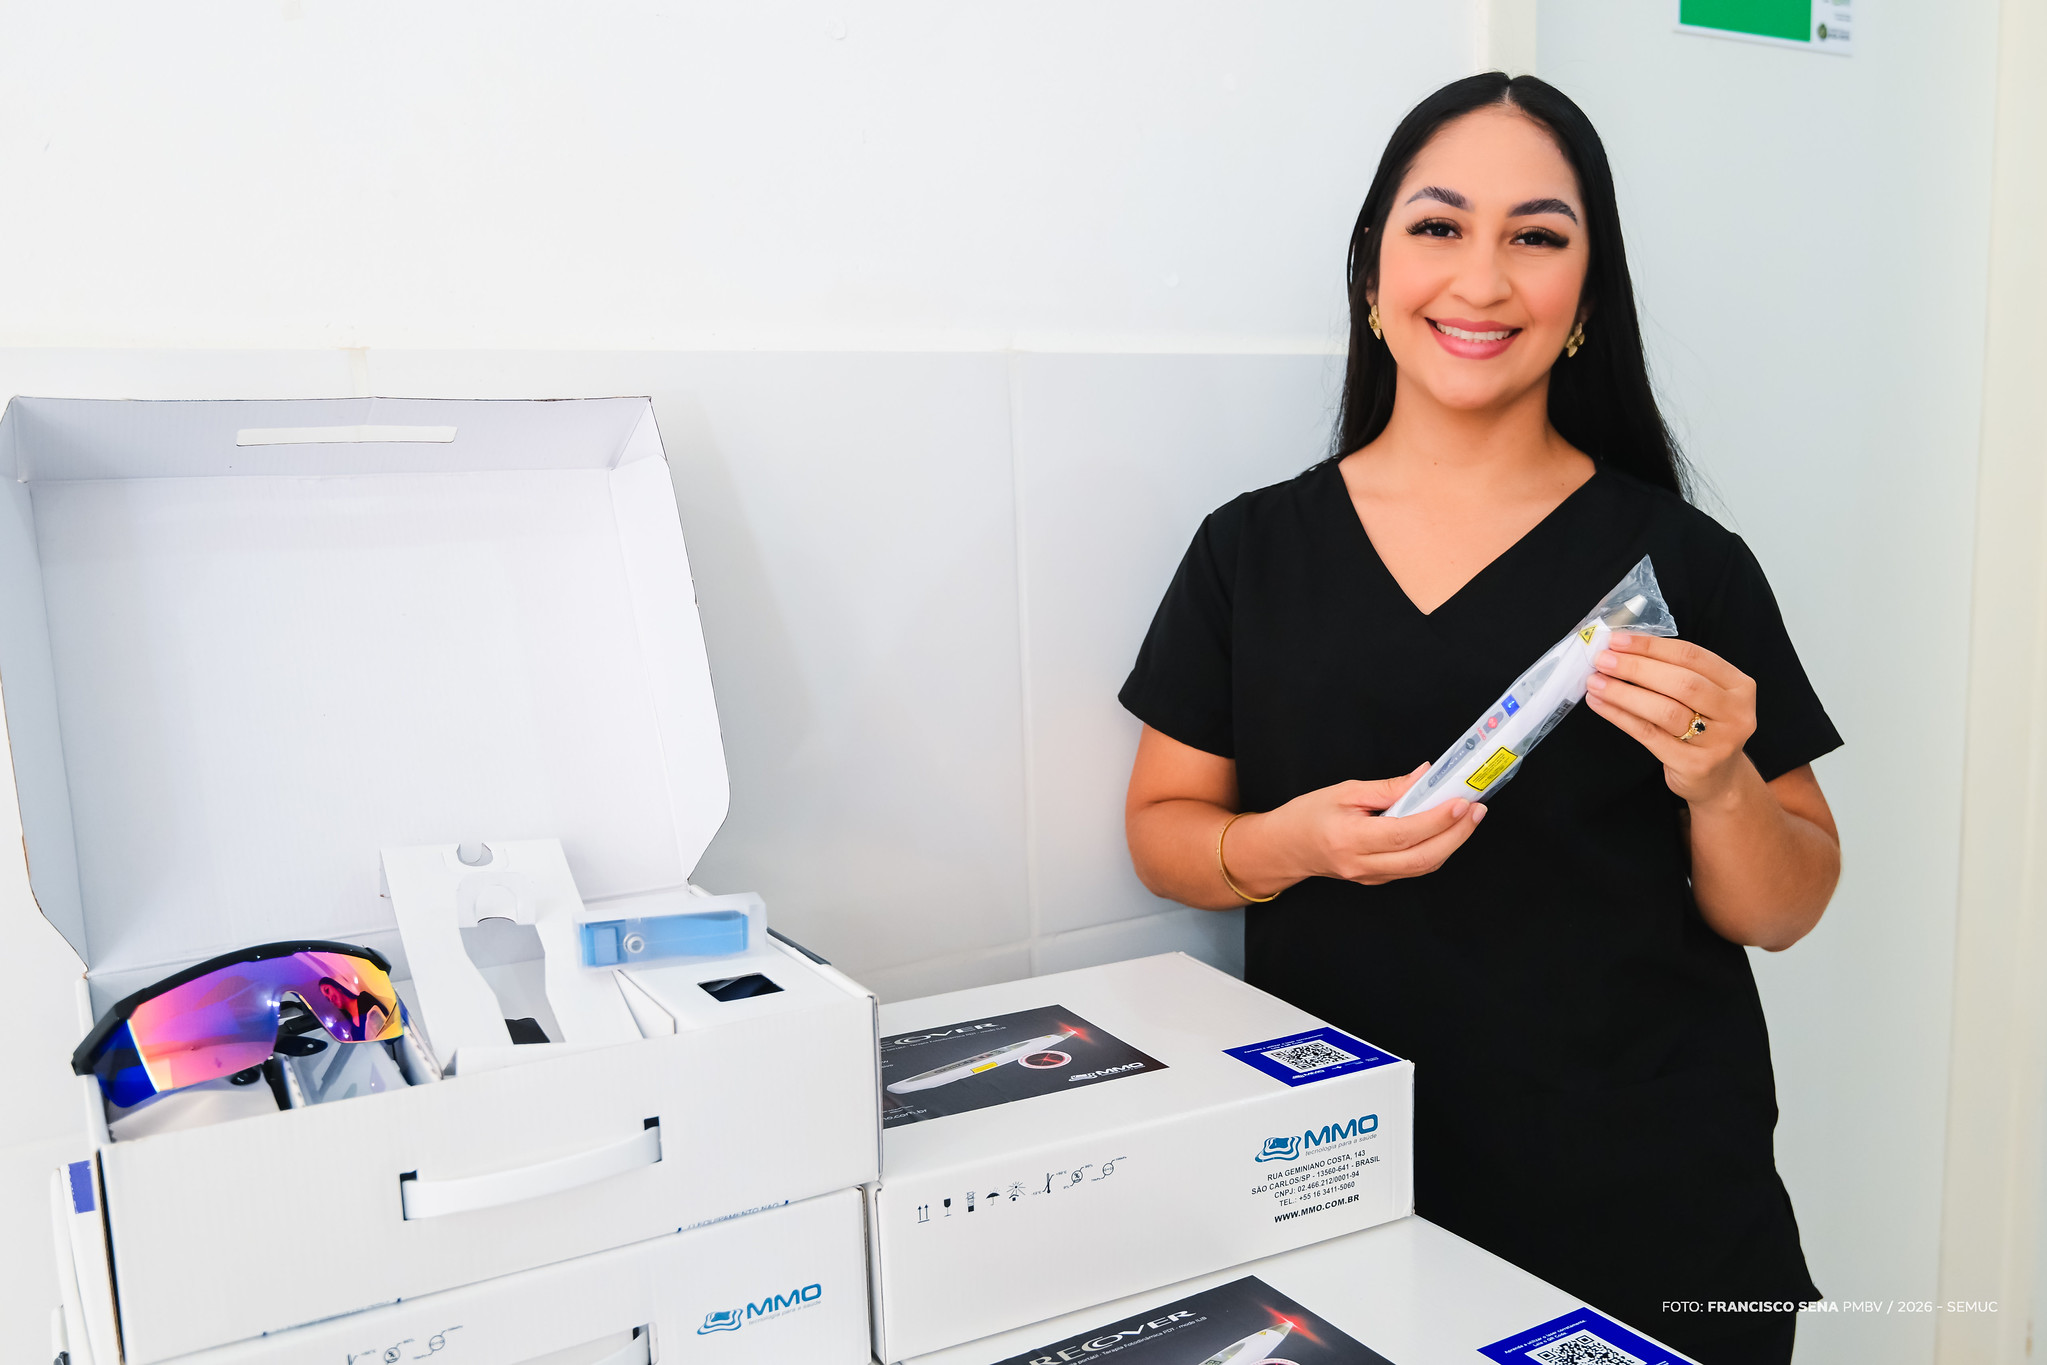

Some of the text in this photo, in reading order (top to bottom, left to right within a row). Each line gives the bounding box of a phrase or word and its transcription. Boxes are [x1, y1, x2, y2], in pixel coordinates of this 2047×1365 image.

[880, 1023, 998, 1049] ECOVER
[1095, 1062, 1143, 1076] MMO
[1304, 1114, 1378, 1149] MMO
[1305, 1144, 1337, 1156] tecnologia
[1338, 1140, 1352, 1149] para
[1359, 1132, 1377, 1142] saúde
[1251, 1185, 1268, 1195] SÃO
[1269, 1174, 1310, 1190] CARLOS/SP
[1316, 1163, 1349, 1179] 13560-641
[1355, 1155, 1380, 1168] BRASIL
[1267, 1149, 1366, 1181] RUA GEMINIANO COSTA, 143
[1274, 1170, 1360, 1199] CNPJ: 02.466.212/0001-94
[1279, 1197, 1297, 1207] TEL.:
[1299, 1193, 1311, 1201] +55
[1322, 1181, 1355, 1196] 3411-5060
[1274, 1193, 1360, 1223] WWW.MMO.COM.BR
[747, 1283, 822, 1319] MMO
[749, 1313, 780, 1325] tecnologia
[782, 1308, 796, 1316] para
[1029, 1310, 1197, 1365] RECOVER
[1102, 1346, 1124, 1355] Terapia
[1178, 1321, 1195, 1329] modo
